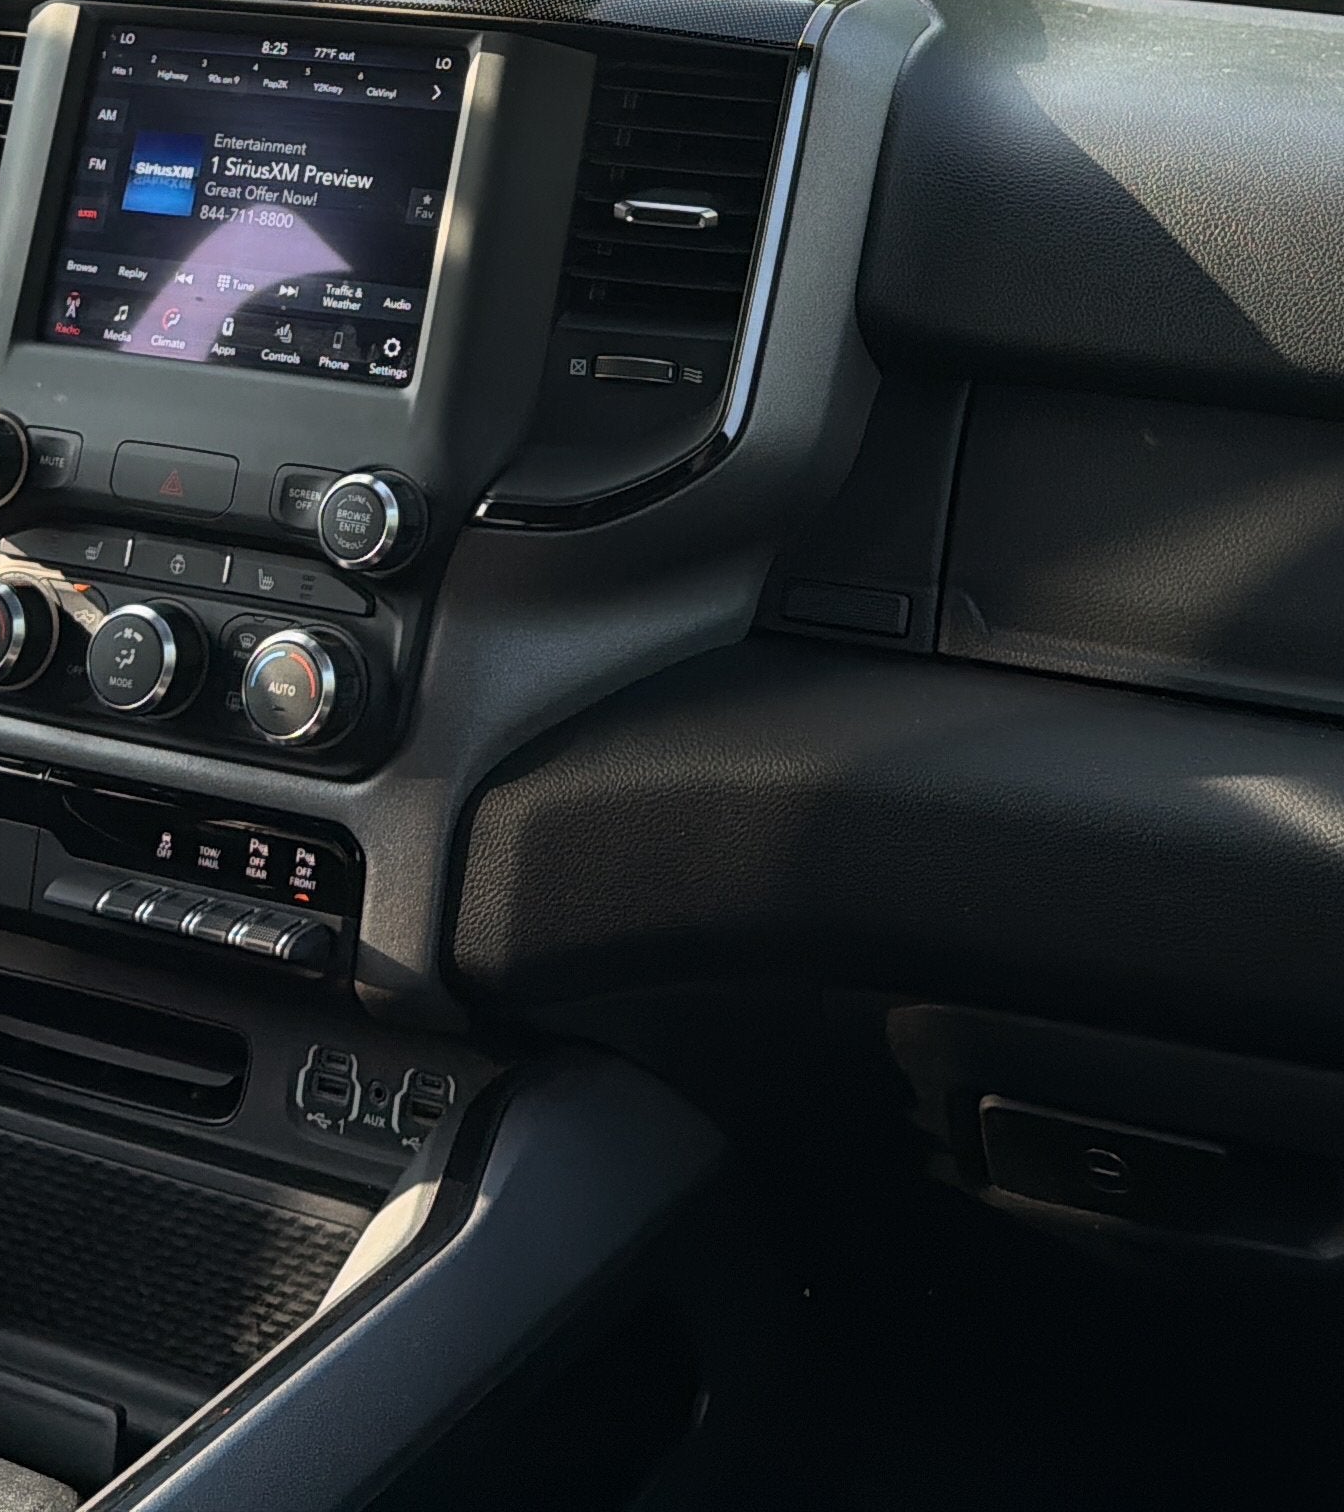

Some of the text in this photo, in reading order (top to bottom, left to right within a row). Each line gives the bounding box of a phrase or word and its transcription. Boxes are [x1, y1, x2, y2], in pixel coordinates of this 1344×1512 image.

[119, 32, 135, 45] LO
[261, 40, 288, 55] 8:25
[338, 50, 356, 62] out
[435, 57, 452, 70] LO
[97, 109, 118, 122] AM
[214, 133, 308, 156] Entertainment
[88, 157, 107, 171] FM
[211, 155, 374, 190] 1 SiriusXM Preview
[204, 181, 318, 207] Great Offer Now!
[199, 204, 294, 229] 844-711-8800
[415, 206, 434, 219] Fav
[66, 259, 98, 274] Browse
[117, 265, 148, 281] Replay
[232, 279, 255, 292] Tune
[325, 283, 354, 298] Traffic
[322, 296, 362, 311] Weather
[383, 297, 412, 311] Audio
[54, 321, 82, 336] Radio
[103, 328, 132, 343] Media
[150, 334, 186, 350] Climate
[211, 342, 236, 357] Apps
[261, 348, 301, 364] Controls
[318, 355, 350, 371] Phone
[369, 362, 408, 380] Settings
[39, 455, 65, 469] MUTE
[289, 488, 322, 501] SCREEN
[347, 494, 367, 505] TUNE
[295, 499, 312, 510] OFF
[336, 508, 371, 523] BROWSE
[338, 521, 367, 535] ENTER
[109, 675, 133, 689] MODE
[268, 680, 296, 697] AUTO
[156, 847, 173, 859] OFF
[199, 845, 222, 858] TOW/
[198, 856, 219, 870] HAUL
[249, 856, 266, 867] OFF
[245, 866, 267, 880] REAR
[295, 865, 313, 878] OFF
[288, 876, 317, 890] FRONT
[362, 1113, 386, 1129] AUX
